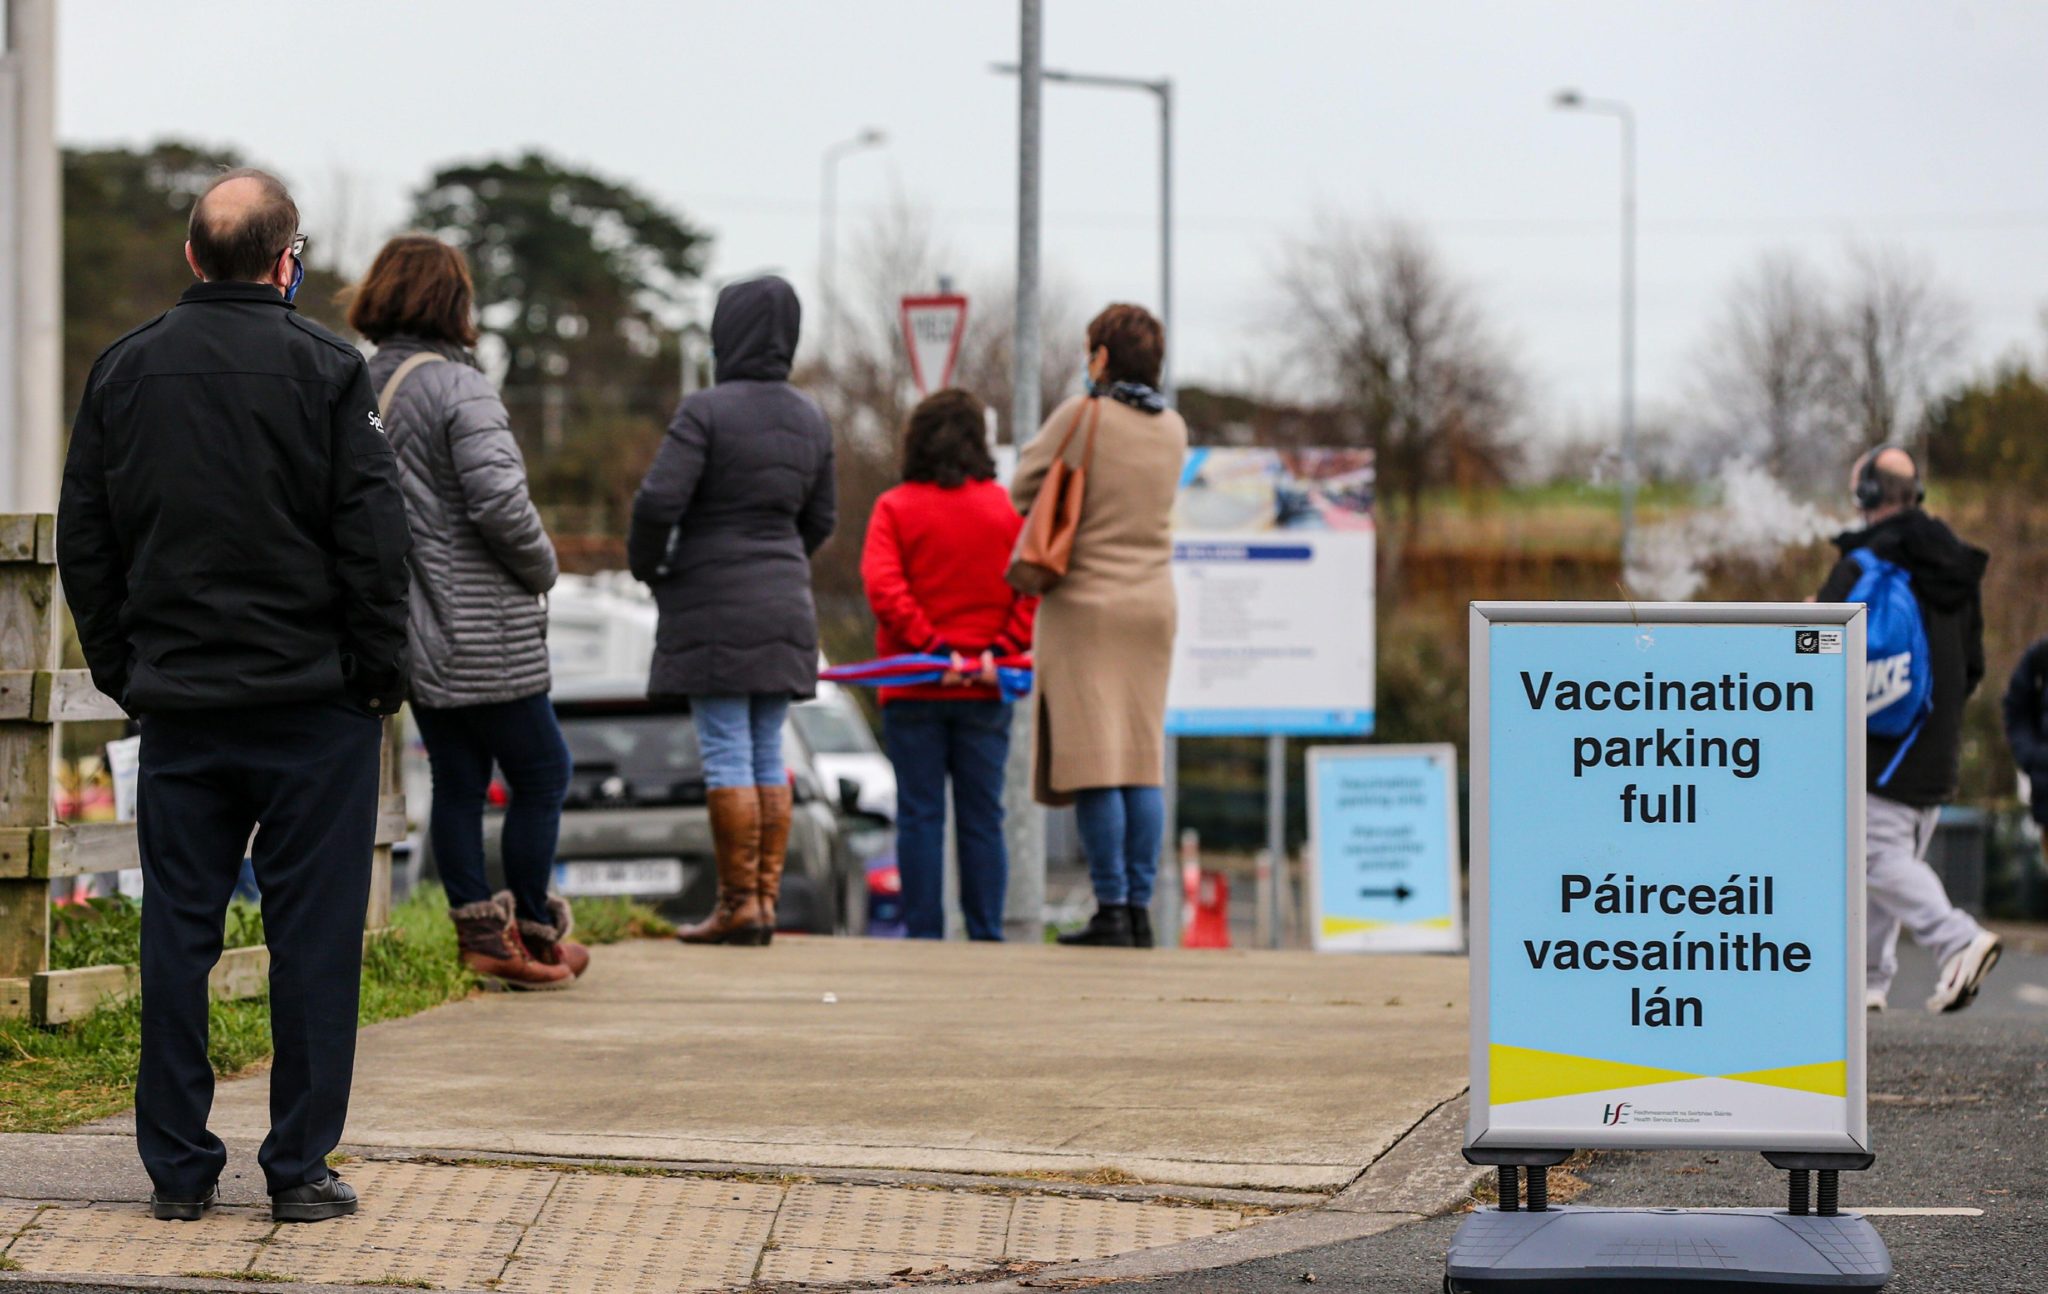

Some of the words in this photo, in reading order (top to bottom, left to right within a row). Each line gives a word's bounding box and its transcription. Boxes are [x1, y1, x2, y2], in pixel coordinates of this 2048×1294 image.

[1519, 671, 1814, 712] Vaccination
[1573, 727, 1760, 779] parking
[1619, 783, 1696, 824] full
[1561, 872, 1773, 916] Páirceáil
[1523, 930, 1812, 973] vacsaínithe
[1631, 986, 1703, 1028] lán
[1602, 1102, 1632, 1126] HSE
